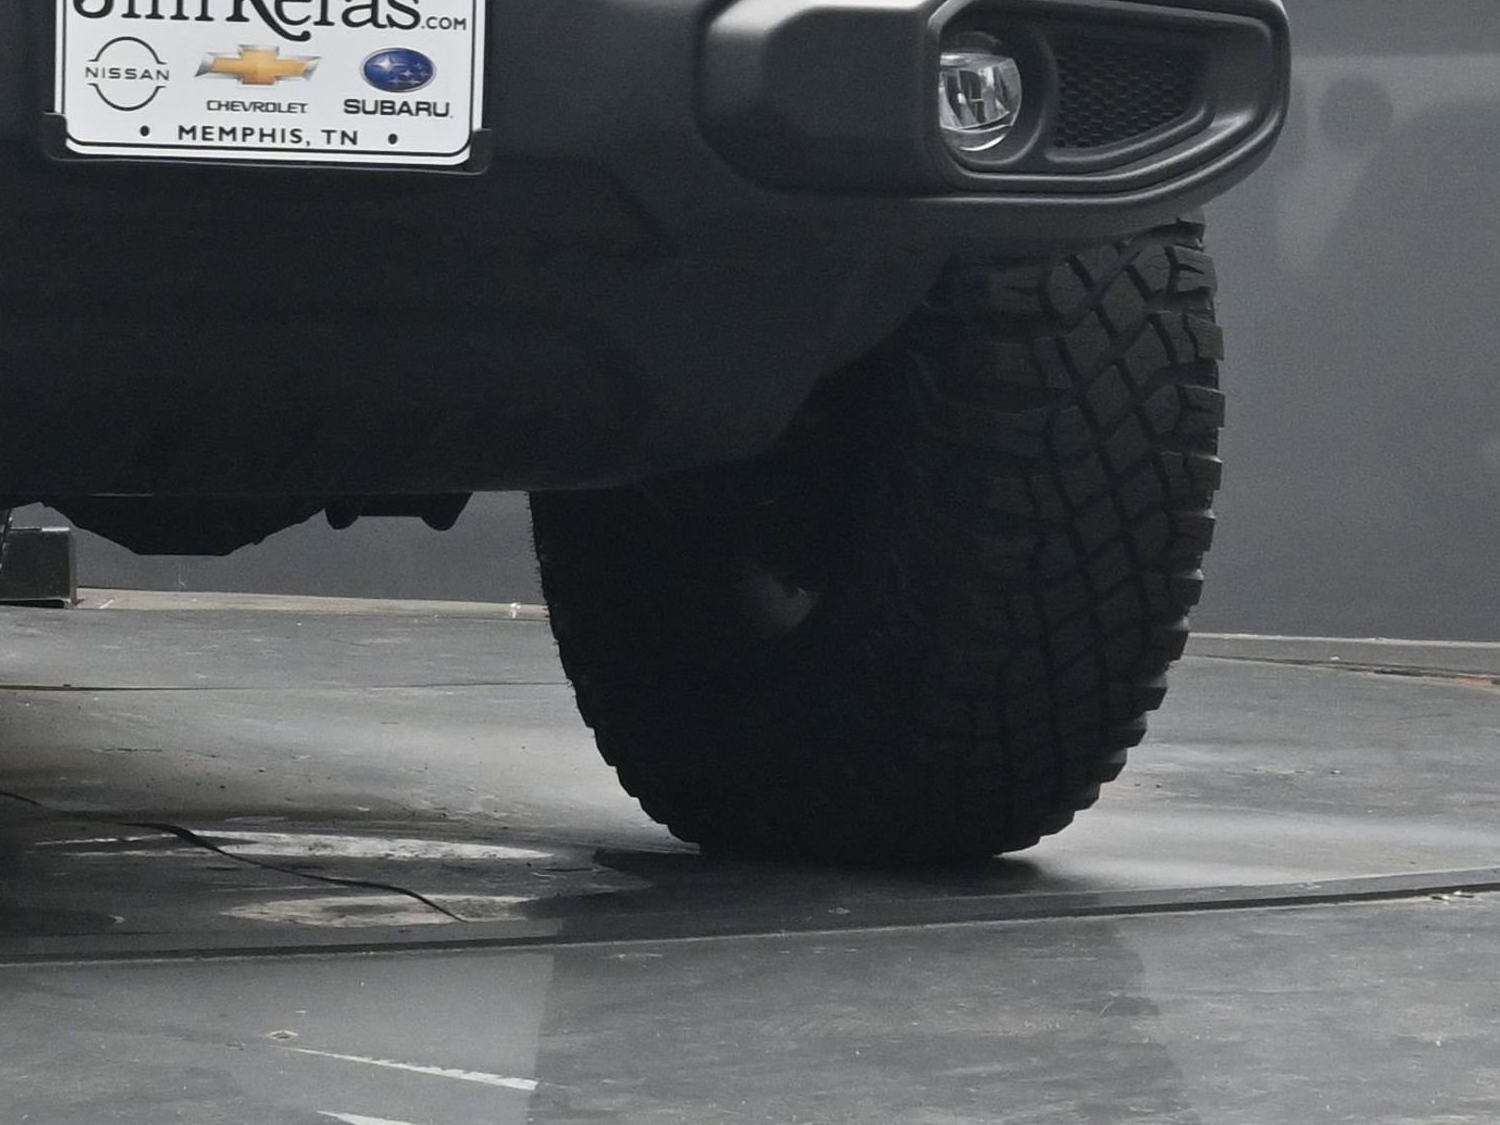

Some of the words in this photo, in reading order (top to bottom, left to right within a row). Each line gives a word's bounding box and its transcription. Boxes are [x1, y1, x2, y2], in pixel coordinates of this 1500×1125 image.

[85, 66, 170, 81] NISSAN
[206, 99, 308, 114] CHEVROLET
[343, 98, 450, 118] SUBARU
[177, 124, 311, 146] MEMPHIS,
[321, 129, 358, 146] TN
